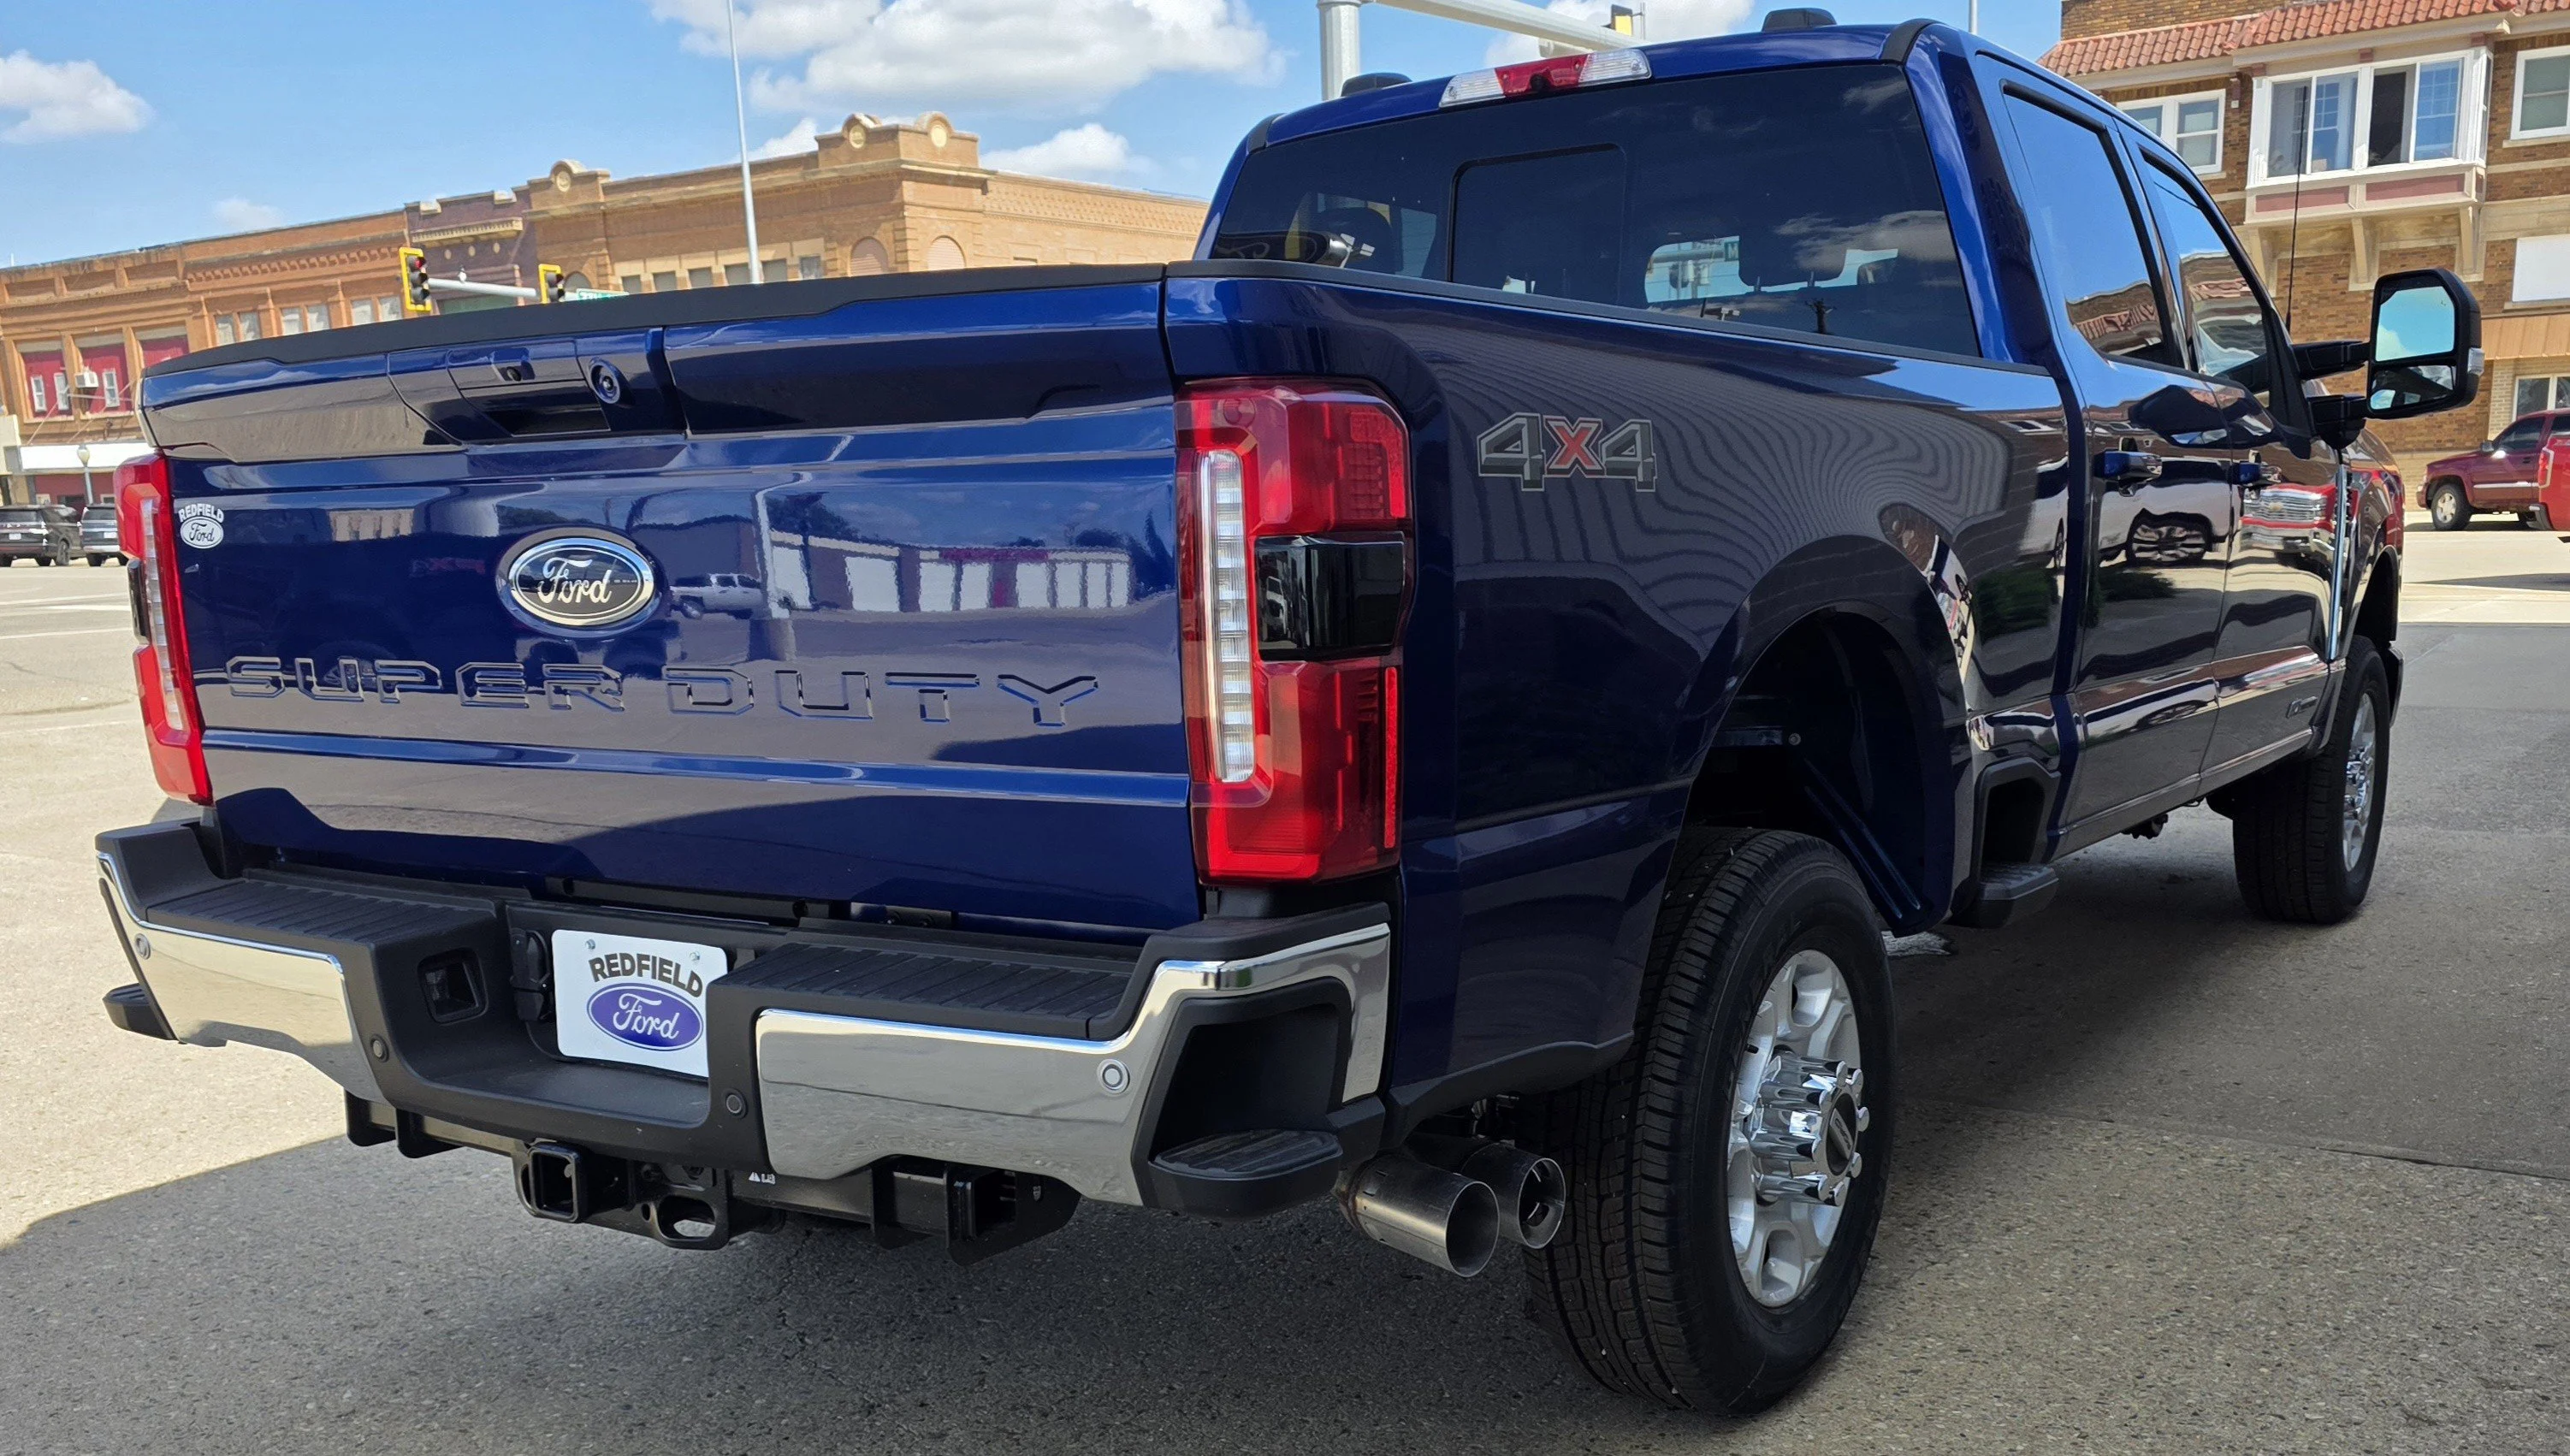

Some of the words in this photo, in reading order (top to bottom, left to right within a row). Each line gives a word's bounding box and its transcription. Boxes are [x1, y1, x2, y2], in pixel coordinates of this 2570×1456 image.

[178, 503, 224, 523] REDFIELD
[189, 522, 215, 542] Ford
[536, 556, 613, 603] Ford
[226, 656, 625, 712] SUPER
[662, 666, 1098, 727] DUTY
[589, 952, 703, 997] REDFIELD
[613, 993, 679, 1039] Ford
